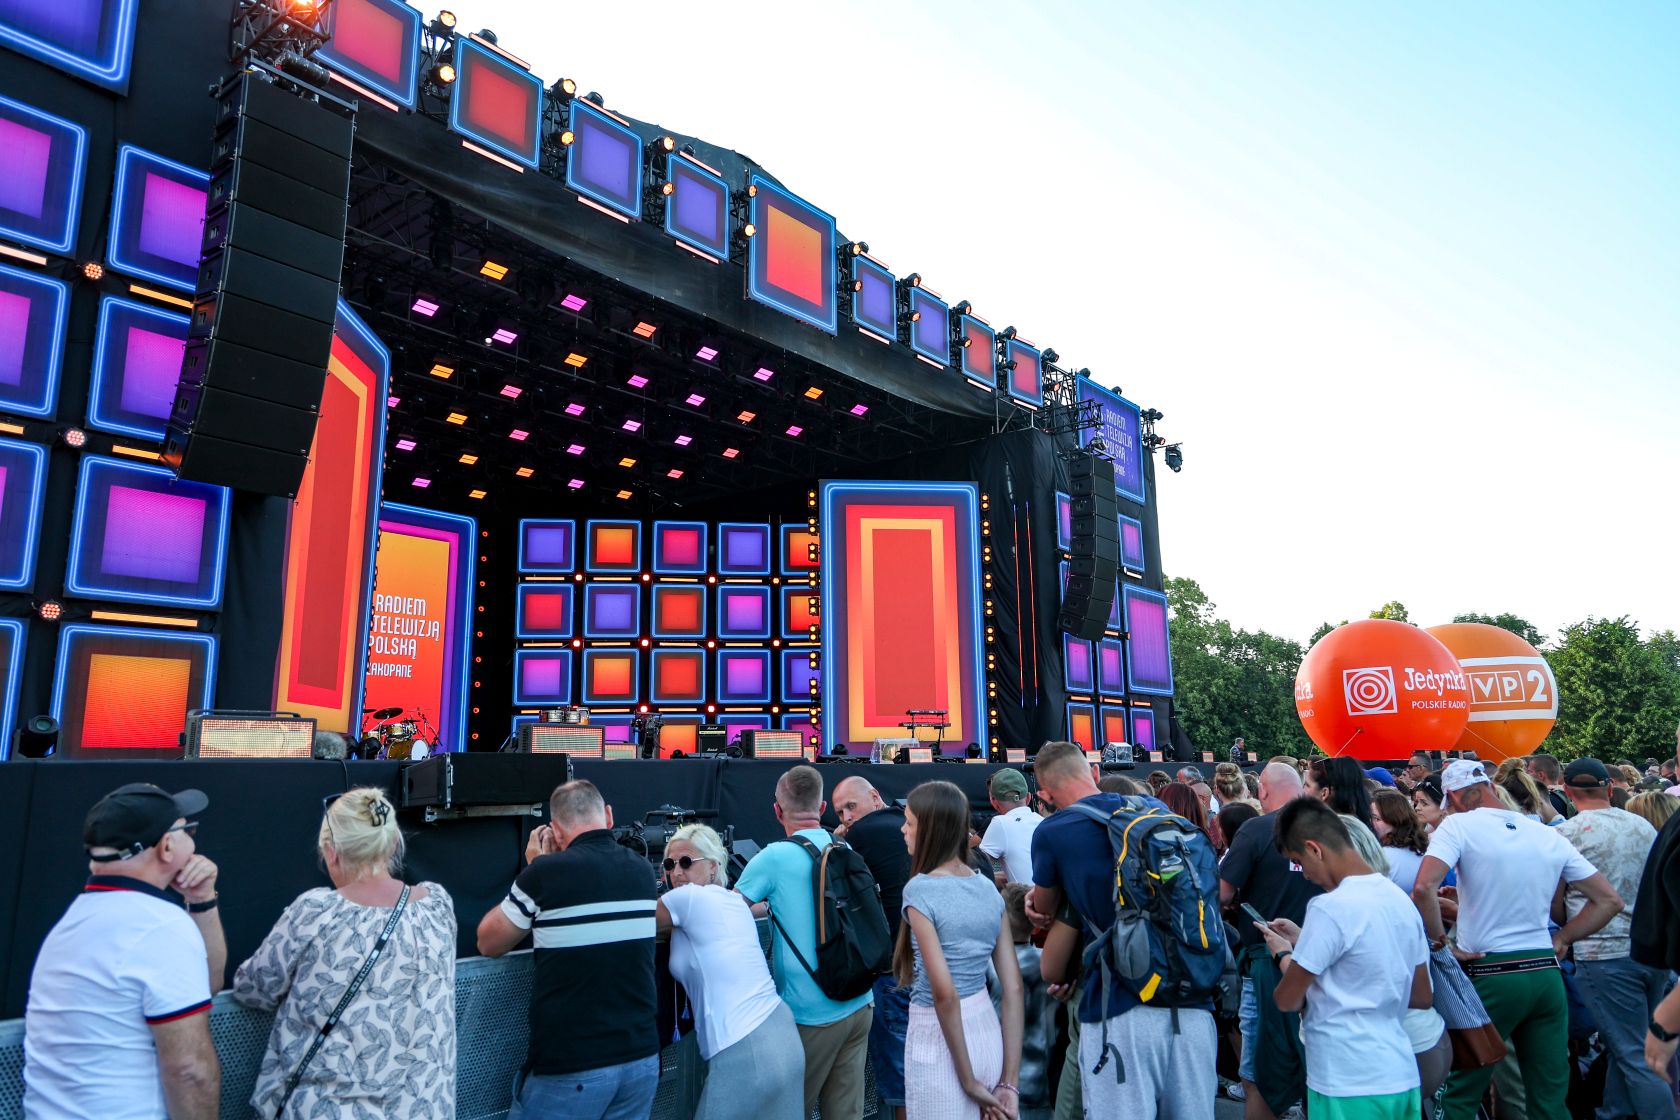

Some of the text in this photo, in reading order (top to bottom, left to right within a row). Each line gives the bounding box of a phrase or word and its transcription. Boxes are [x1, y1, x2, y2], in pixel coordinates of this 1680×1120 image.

[375, 593, 427, 616] RADIEM
[373, 614, 440, 641] TELEWIZJĄ
[368, 635, 417, 660] POLSKĄ
[1404, 667, 1467, 697] Jedynka
[1411, 700, 1467, 709] POLSKIE RADIO
